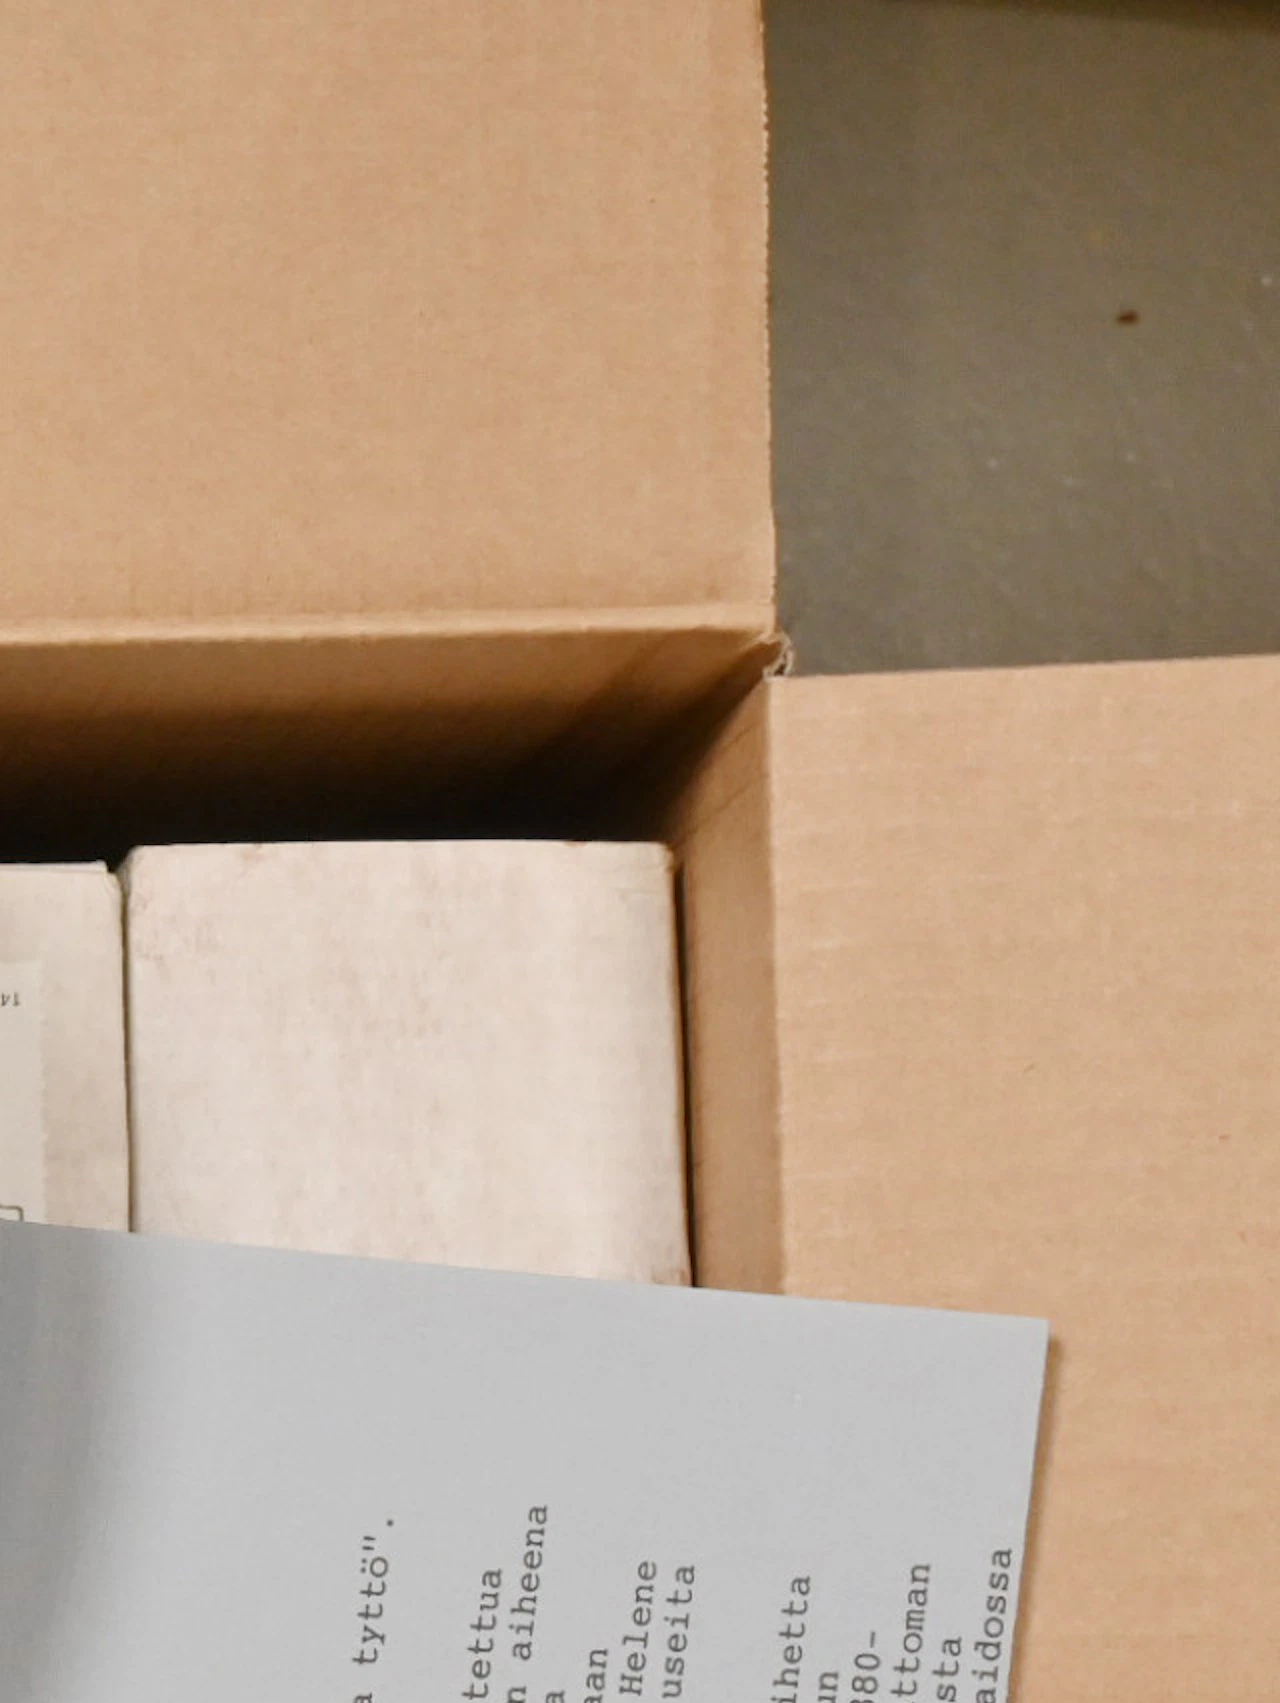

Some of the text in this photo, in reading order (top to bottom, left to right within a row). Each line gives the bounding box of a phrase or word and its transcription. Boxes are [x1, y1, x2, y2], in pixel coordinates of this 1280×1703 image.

[507, 1504, 549, 1662] aiheena
[617, 1559, 658, 1698] Helene
[660, 1564, 696, 1700] useita
